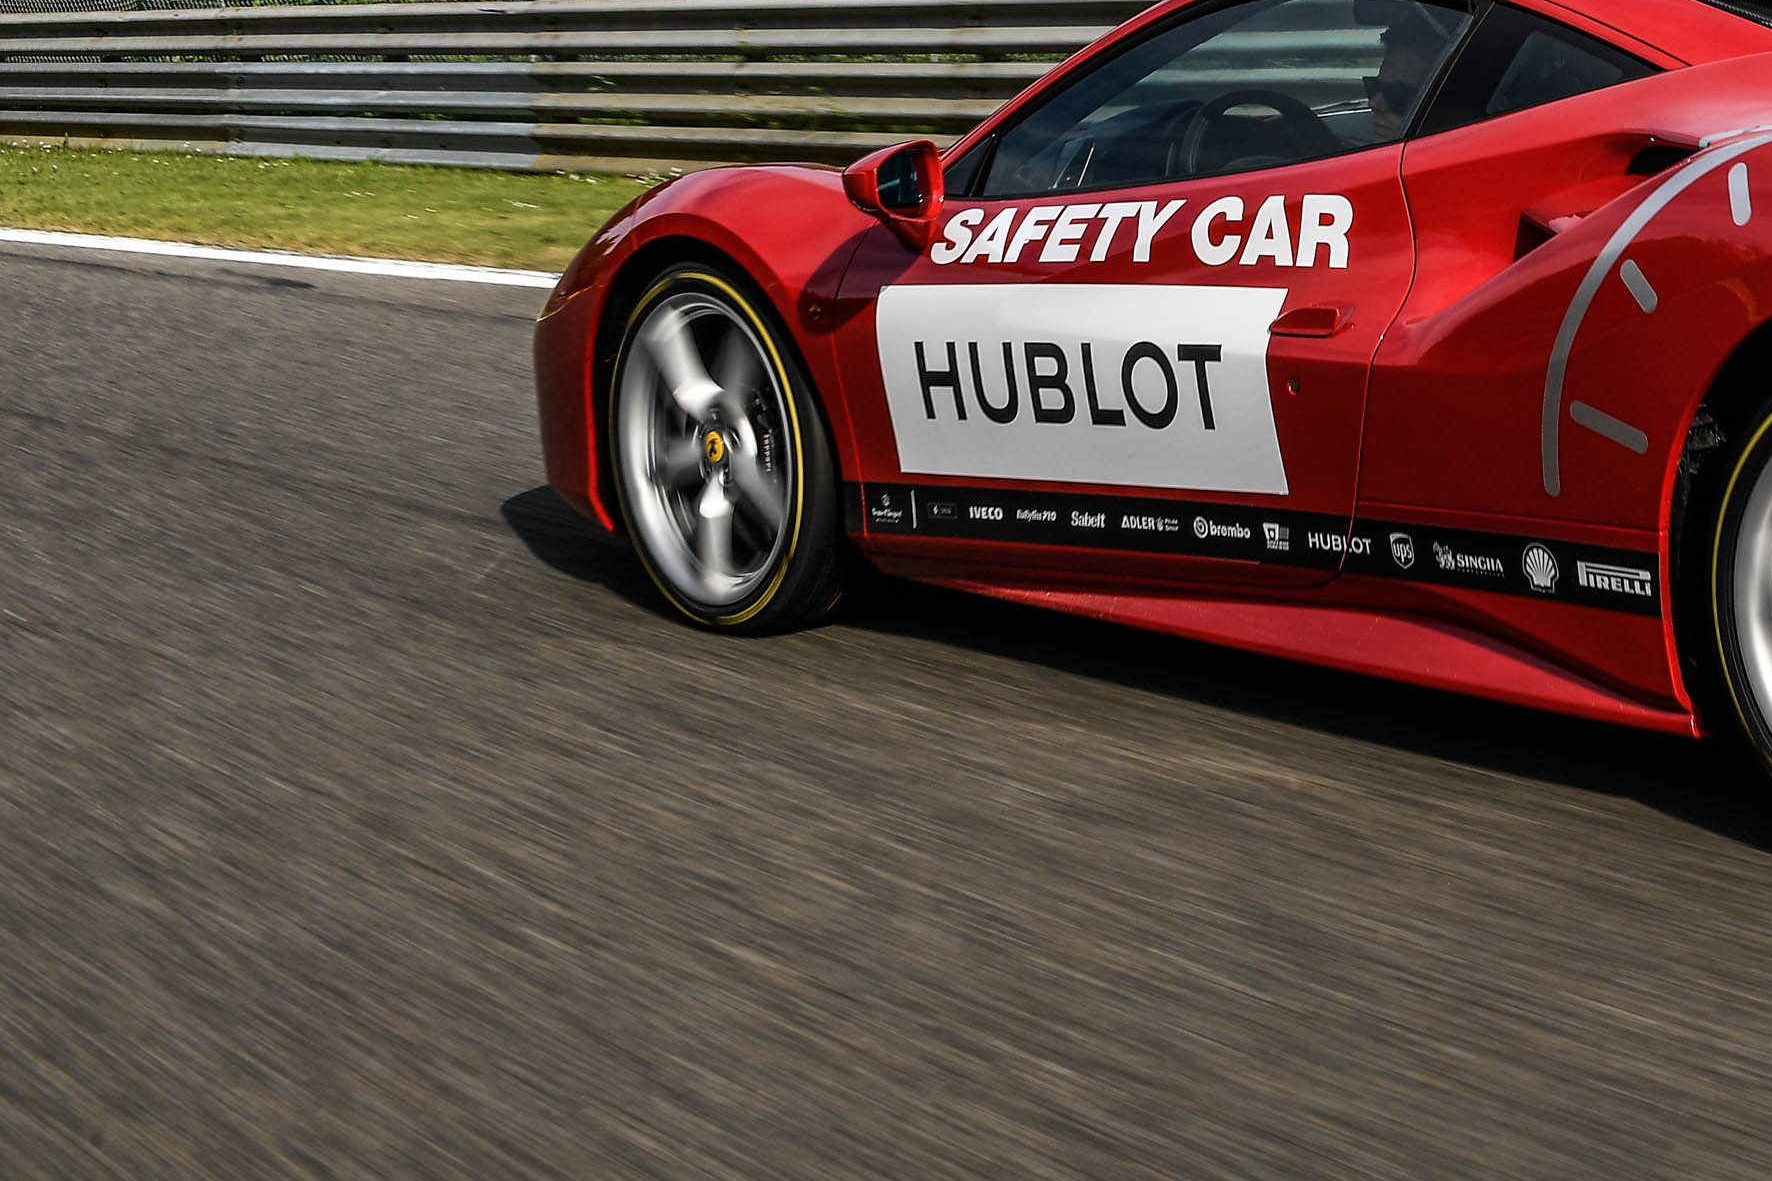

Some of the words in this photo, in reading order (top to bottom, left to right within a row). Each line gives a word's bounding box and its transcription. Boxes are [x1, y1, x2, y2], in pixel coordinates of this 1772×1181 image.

[930, 199, 1187, 265] SAFETY
[1191, 194, 1354, 269] CAR
[914, 340, 1222, 431] HUBLOT
[969, 505, 1003, 520] IVECO
[1071, 510, 1106, 528] Sabelt
[1121, 515, 1155, 531] ADLER
[1210, 521, 1251, 539] brembo
[1308, 531, 1371, 555] HUBLOT
[1393, 542, 1413, 564] ups
[1456, 553, 1504, 573] SINGHA
[1577, 560, 1652, 596] PIRELLI
